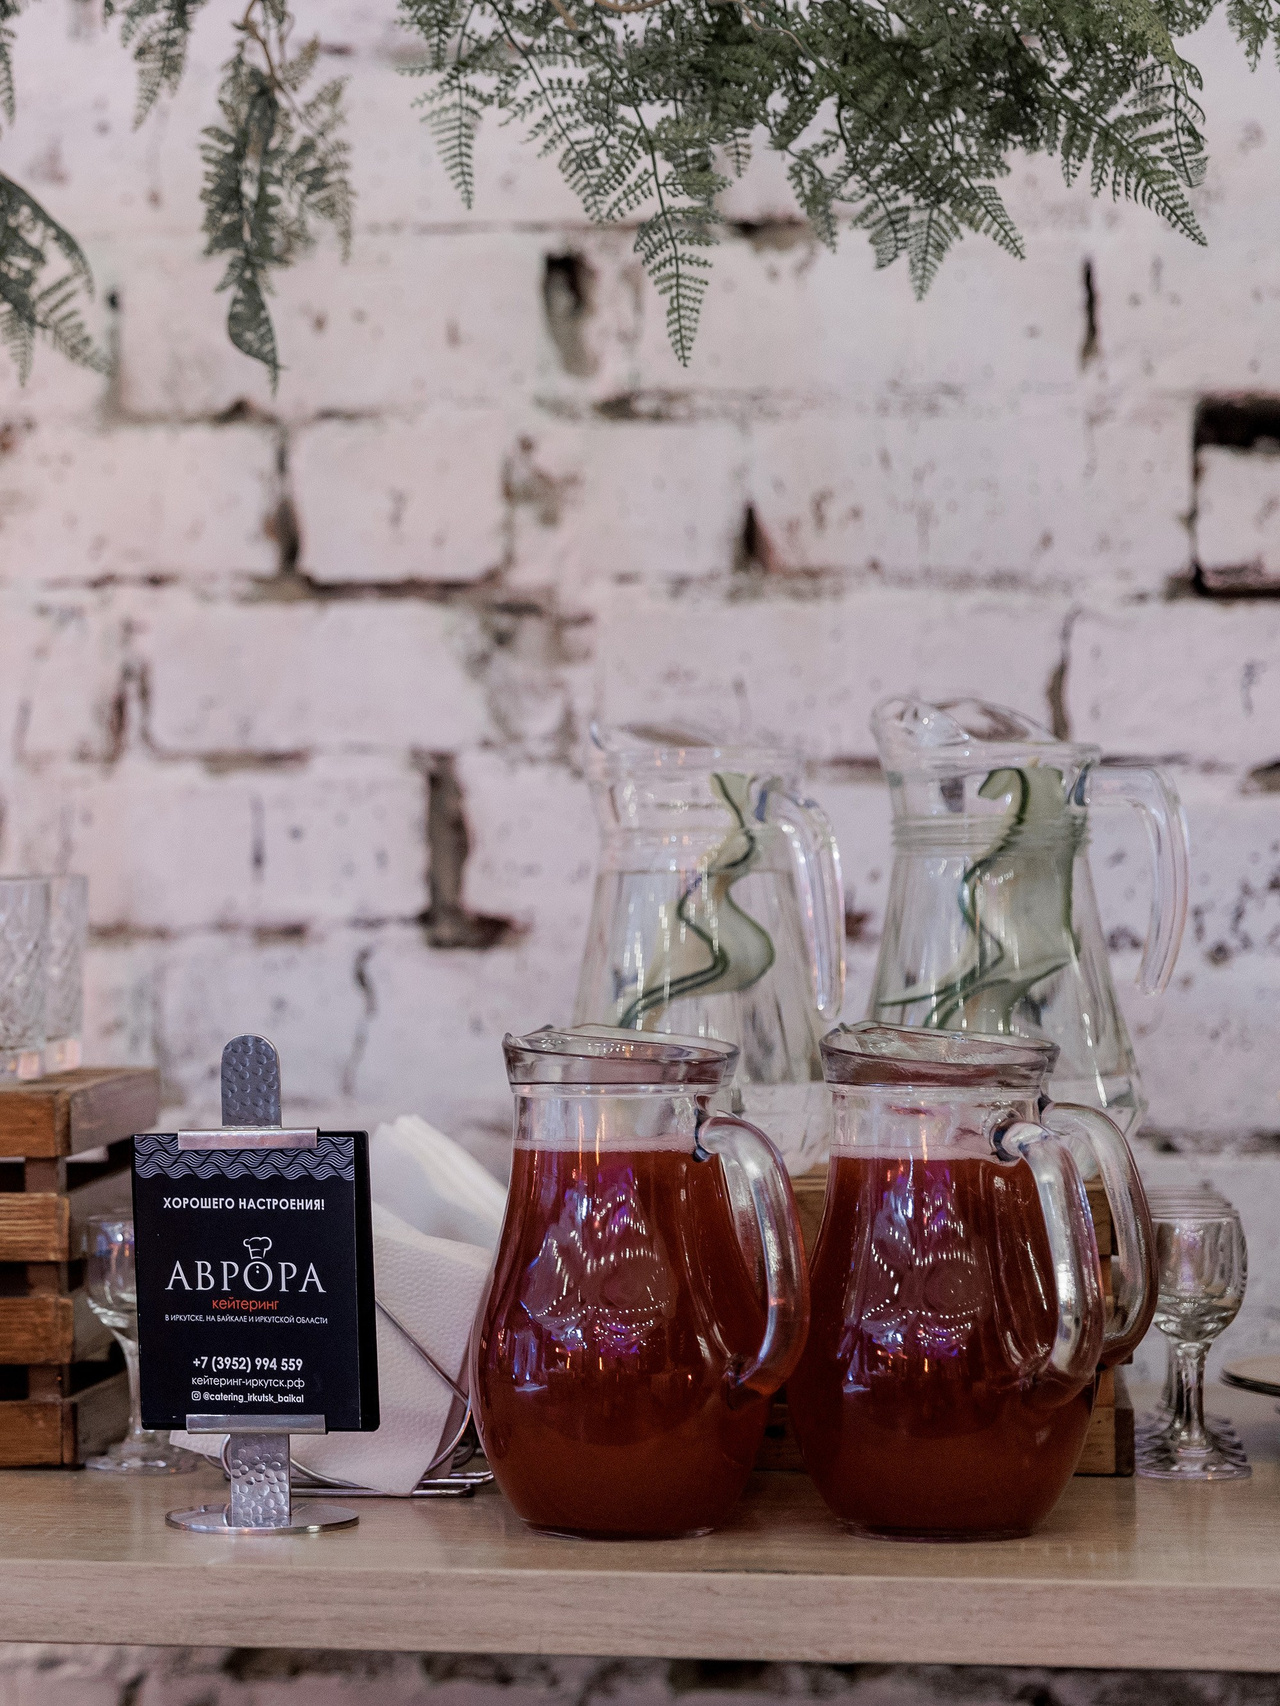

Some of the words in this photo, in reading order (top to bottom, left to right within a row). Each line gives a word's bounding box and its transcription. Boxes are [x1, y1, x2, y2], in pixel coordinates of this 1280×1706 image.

[163, 1197, 235, 1210] ХОРОШЕГО
[238, 1197, 325, 1211] НАСТРОЕНИЯ!
[165, 1260, 327, 1293] АВРОРА
[212, 1296, 280, 1312] кейтеринг
[164, 1313, 170, 1322] В
[205, 1314, 216, 1322] НА
[216, 1313, 248, 1323] БАЙКАЛЕ
[248, 1315, 254, 1323] И
[255, 1314, 295, 1324] ИРКУТСКОЙ
[295, 1316, 329, 1325] ОБЛАСТИ
[192, 1356, 209, 1369] +7
[211, 1356, 252, 1373] (3952)
[255, 1357, 278, 1371] 994
[280, 1358, 304, 1371] 559
[191, 1375, 306, 1390] кейтеринг-иркутск.рф
[202, 1391, 305, 1404] @catering_irkutsk_baikal
